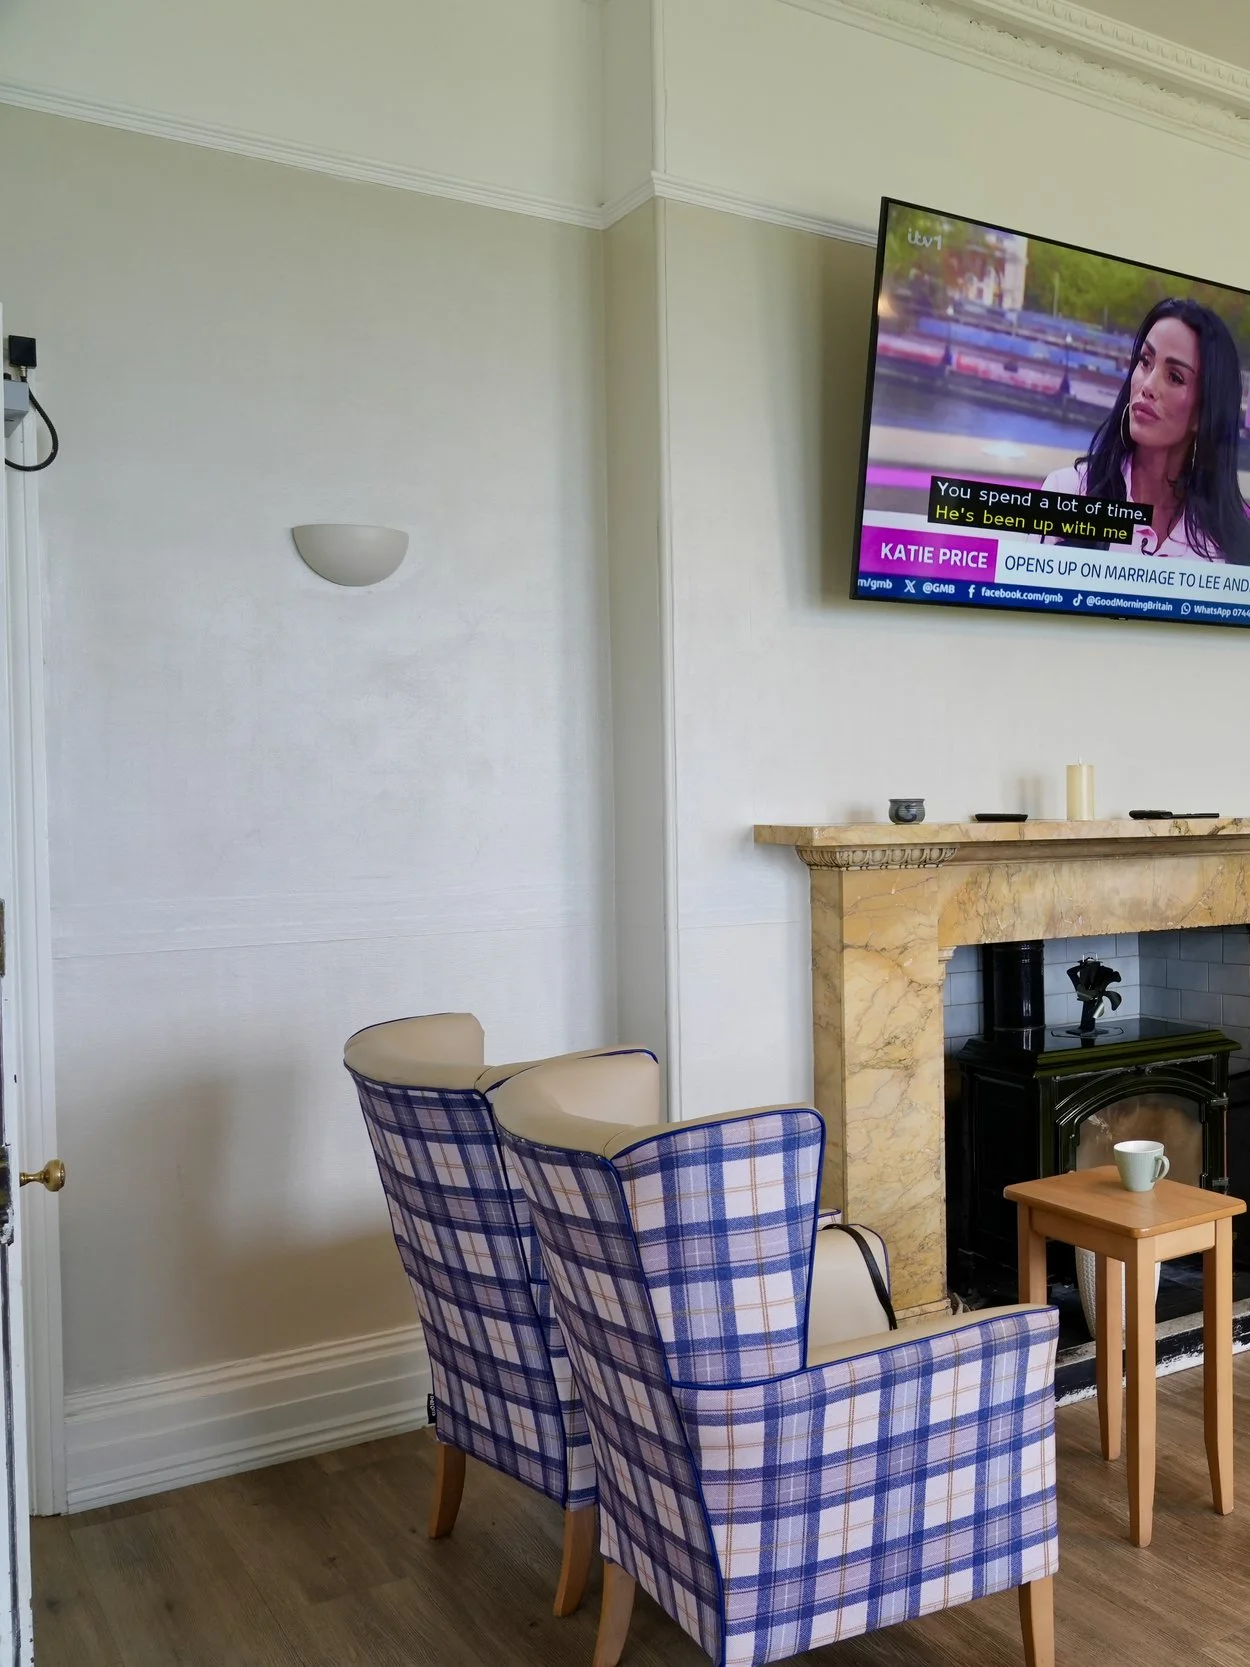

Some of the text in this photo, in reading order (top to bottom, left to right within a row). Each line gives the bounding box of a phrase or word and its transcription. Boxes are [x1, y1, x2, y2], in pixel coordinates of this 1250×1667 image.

[937, 481, 1148, 521] You spend a lot of time.
[936, 505, 1128, 540] He's been up with me
[880, 542, 988, 568] KATIE PRICE
[1005, 556, 1054, 574] OPENS
[1058, 560, 1078, 576] UP
[1080, 562, 1101, 578] ON
[1104, 565, 1175, 586] MARRIAGE
[1179, 572, 1196, 587] TO
[1198, 576, 1220, 590] LEE
[922, 582, 955, 594] @GMB
[982, 586, 1063, 603] facebook.com/gmb
[1086, 596, 1173, 612] @GoodMorningBritain
[1194, 605, 1231, 618] WhatsApp
